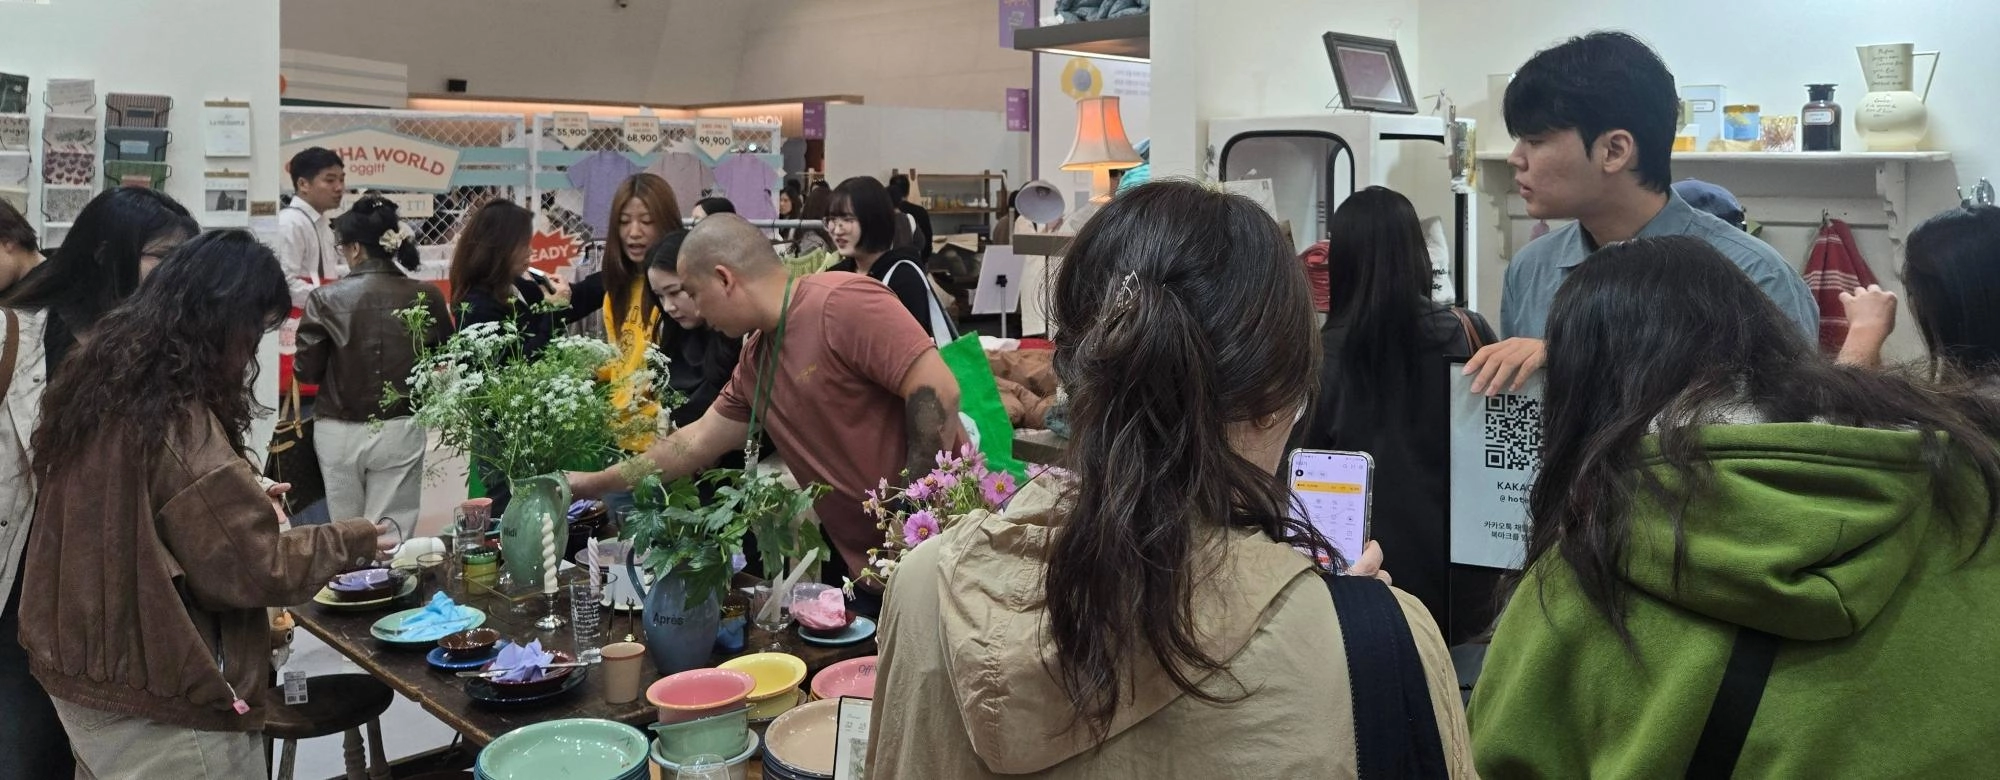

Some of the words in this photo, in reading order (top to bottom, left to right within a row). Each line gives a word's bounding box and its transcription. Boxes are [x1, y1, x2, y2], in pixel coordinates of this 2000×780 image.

[627, 133, 658, 143] 68,900
[699, 136, 731, 147] 99,900
[373, 146, 445, 177] WORLD
[529, 244, 570, 263] EADY
[652, 612, 684, 626] Après
